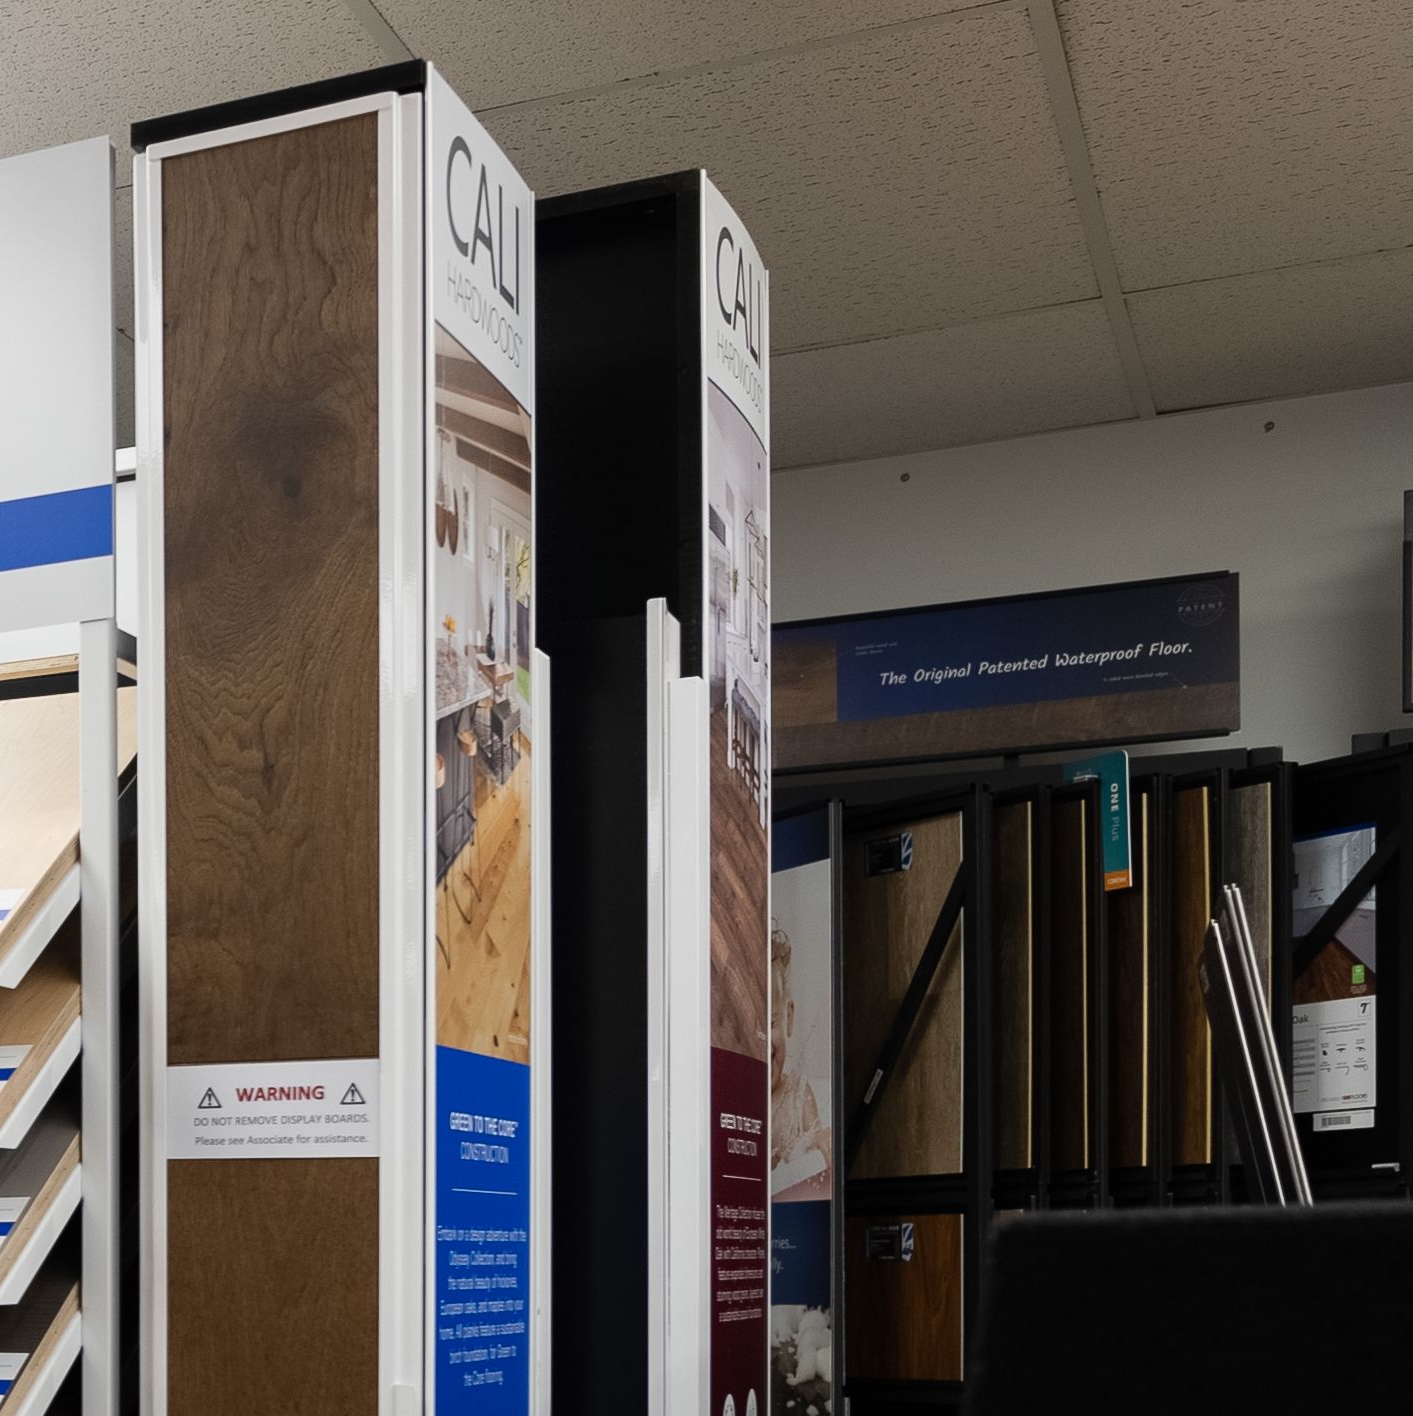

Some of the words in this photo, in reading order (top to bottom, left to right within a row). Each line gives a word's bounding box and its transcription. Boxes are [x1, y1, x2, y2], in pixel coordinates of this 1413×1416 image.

[446, 136, 520, 316] CALI
[716, 226, 761, 370] CALI
[1178, 602, 1224, 613] PATENT
[880, 672, 907, 687] The
[914, 663, 971, 684] Original
[978, 654, 1047, 676] Patented
[1055, 644, 1143, 668] Waterproof
[1149, 641, 1193, 658] Floor.
[1111, 783, 1119, 812] ONE
[236, 1085, 325, 1102] WARNING
[194, 1117, 208, 1127] DO
[211, 1117, 232, 1126] NOT
[235, 1116, 278, 1125] REMOVE
[281, 1115, 322, 1125] DISPLAY
[325, 1114, 369, 1124] BOARDS.
[195, 1136, 224, 1146] Please
[227, 1137, 244, 1146] see
[247, 1135, 293, 1145] Associate
[296, 1135, 311, 1144] for
[312, 1135, 368, 1144] assistance.
